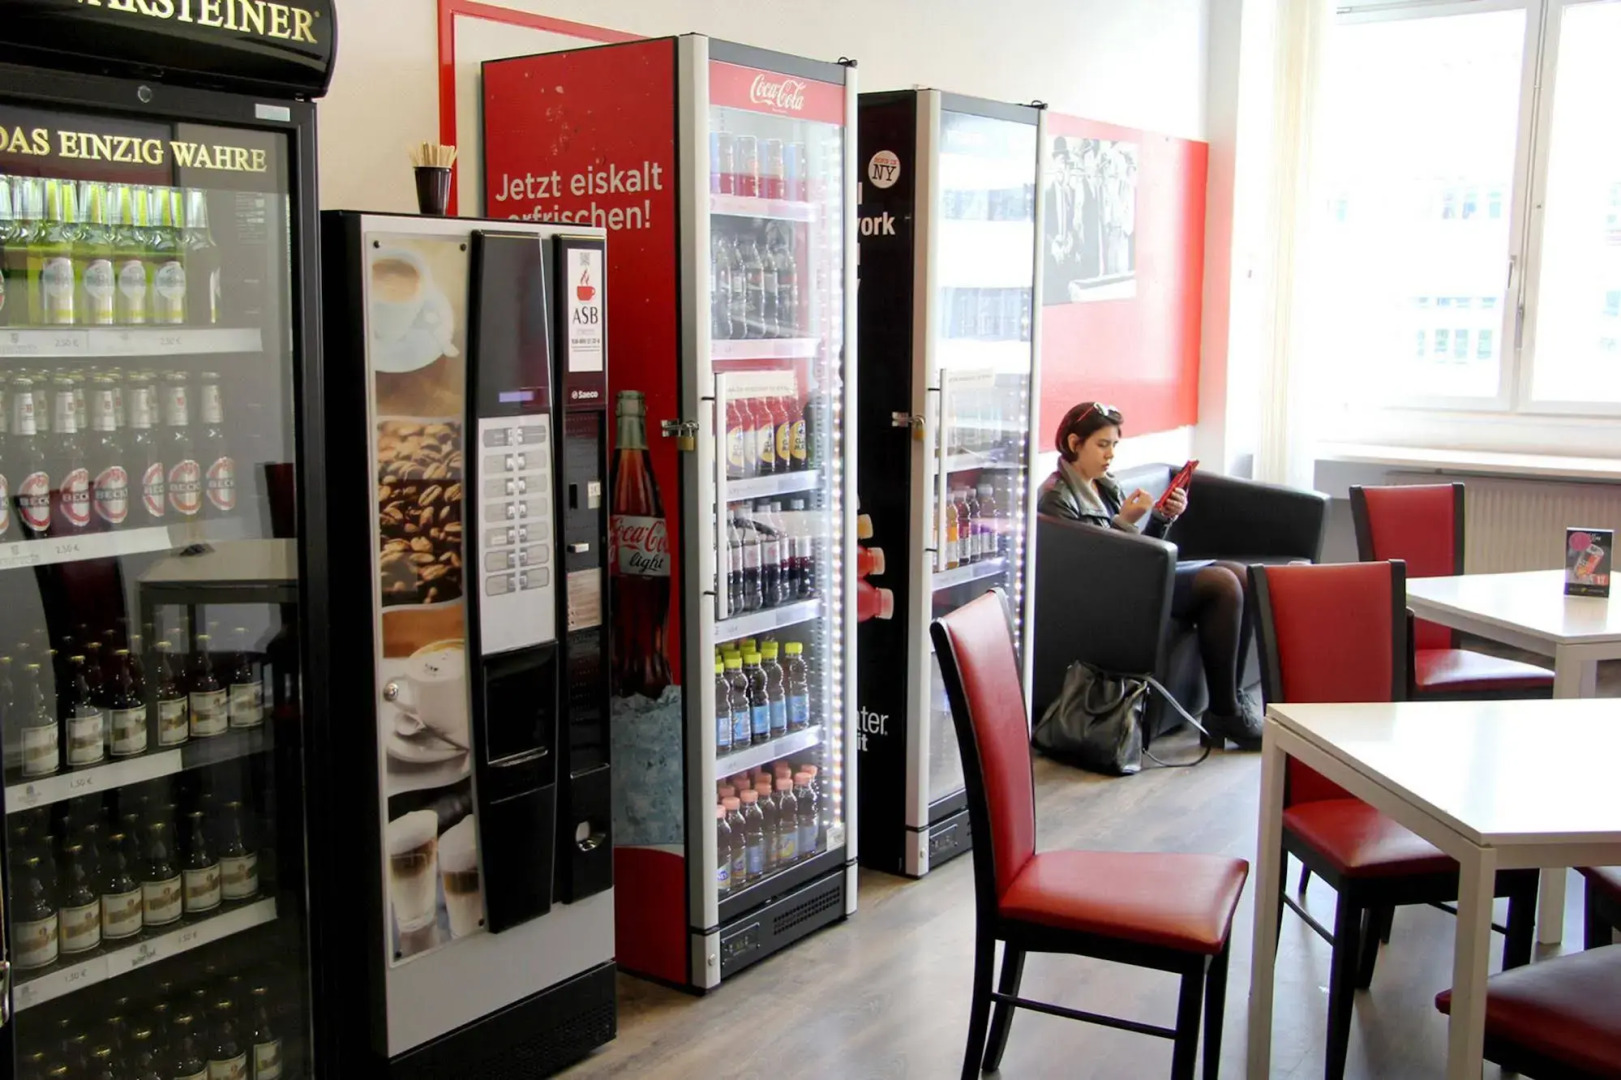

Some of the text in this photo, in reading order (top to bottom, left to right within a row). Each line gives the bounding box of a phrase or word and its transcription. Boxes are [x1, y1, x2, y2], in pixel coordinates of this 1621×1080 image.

[750, 74, 807, 110] Coca-Cola
[58, 130, 164, 165] EINZIG
[169, 140, 268, 172] WAHRE
[495, 161, 663, 202] Jetzt eiskalt
[872, 164, 897, 181] NY
[857, 211, 896, 236] ork
[572, 306, 599, 325] ASB
[629, 552, 664, 573] light
